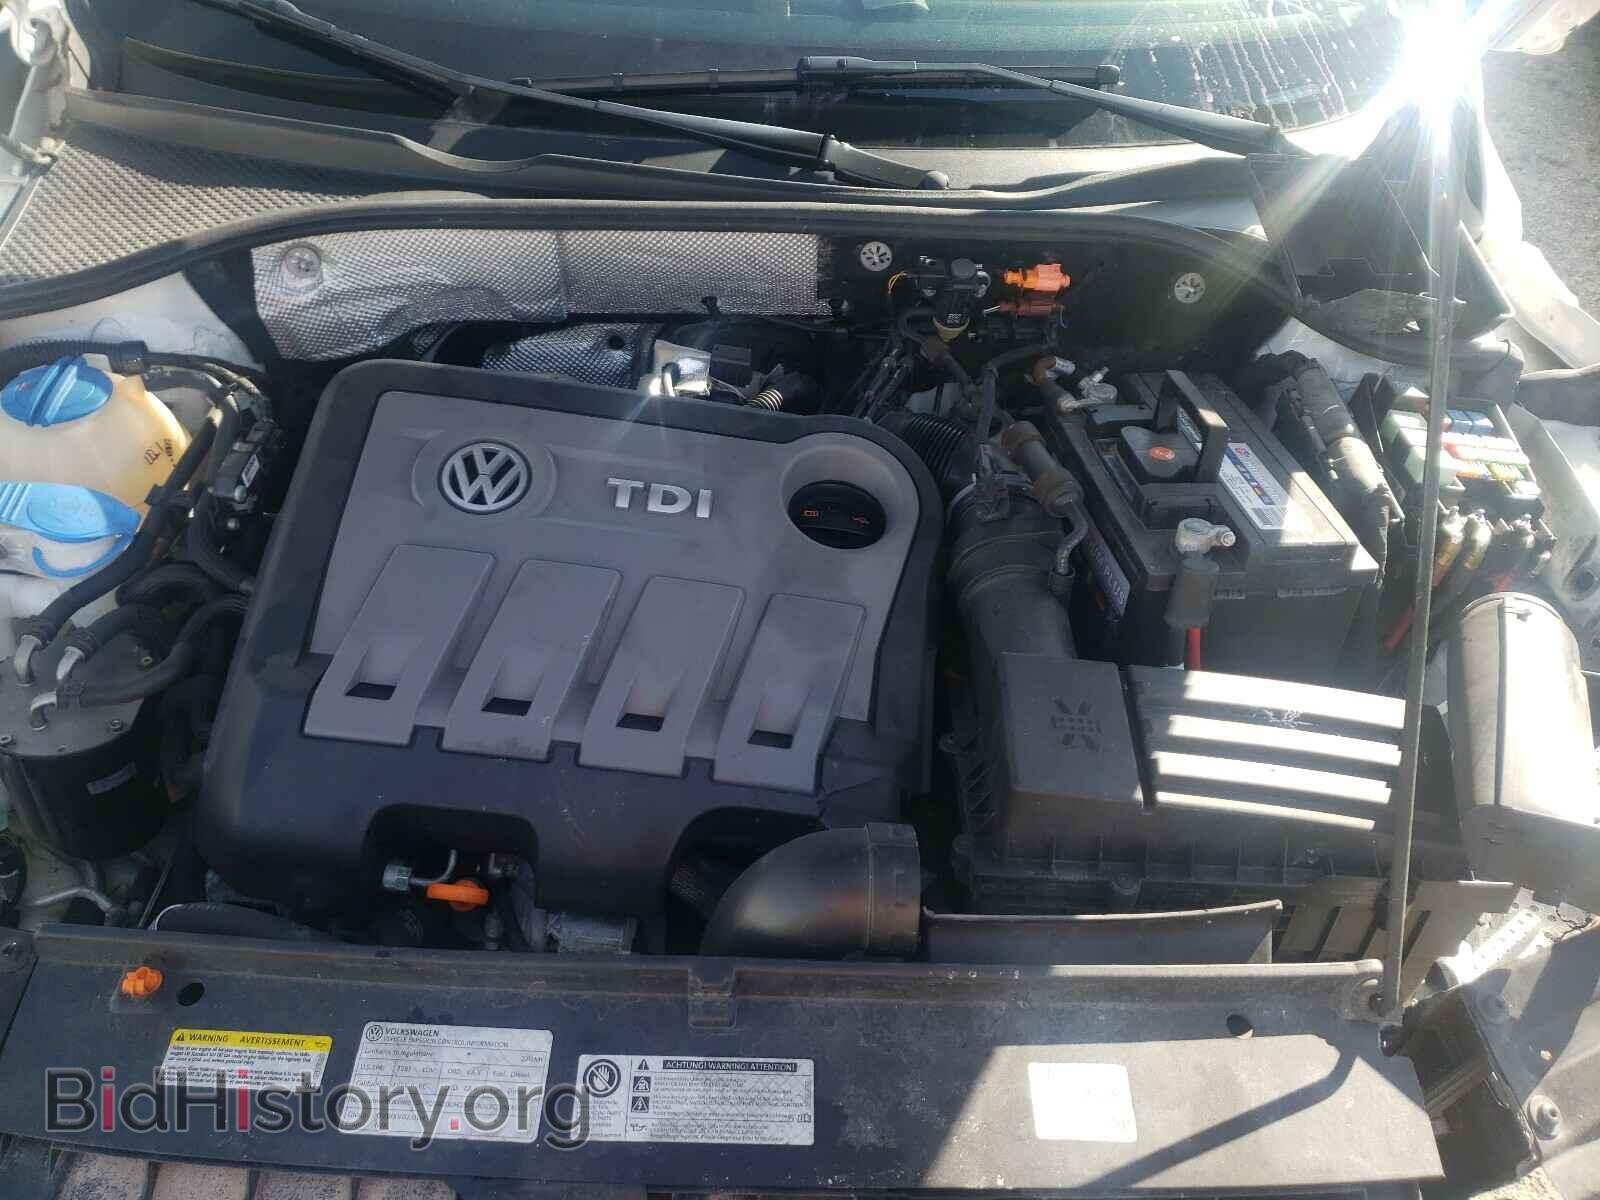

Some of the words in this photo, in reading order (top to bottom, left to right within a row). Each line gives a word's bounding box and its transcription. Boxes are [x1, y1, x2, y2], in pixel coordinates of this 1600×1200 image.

[607, 477, 713, 518] TDI
[385, 1028, 440, 1037] VOLKSWAGEN
[189, 1033, 229, 1042] WARNING
[240, 1035, 305, 1046] AVERTISSEMENT
[666, 1061, 707, 1070] ACHTUNG!
[708, 1061, 749, 1071] WARNING!
[751, 1062, 796, 1072] ATTENTION!
